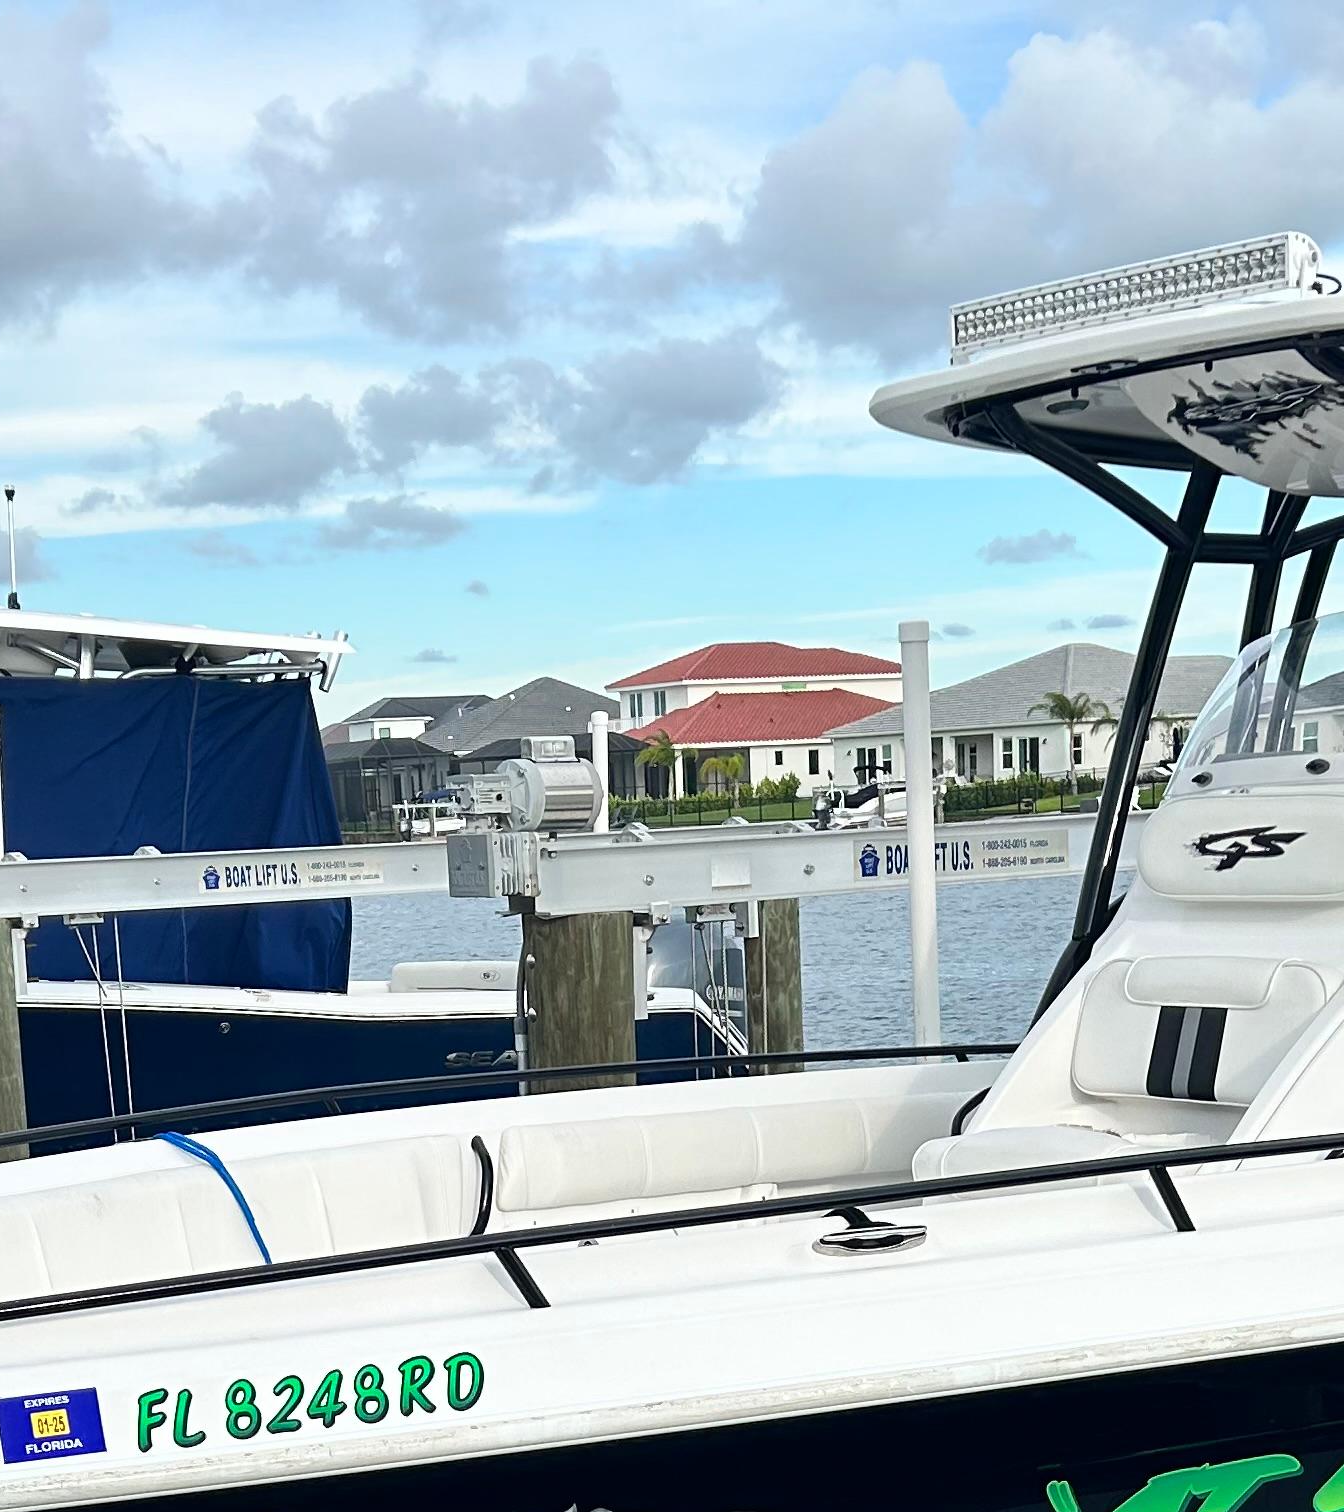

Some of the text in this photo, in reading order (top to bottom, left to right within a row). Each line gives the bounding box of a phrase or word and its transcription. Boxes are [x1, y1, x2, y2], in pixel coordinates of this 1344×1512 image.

[885, 844, 909, 875] BOA
[951, 840, 974, 871] U.S.
[225, 865, 252, 888] BOAT
[255, 864, 277, 886] LIFT
[281, 862, 301, 885] U.S.
[23, 1395, 70, 1409] EXPIRES
[137, 1351, 485, 1453] FL 8248RD
[37, 1415, 66, 1435] 01-25
[25, 1438, 83, 1454] FLORIDA
